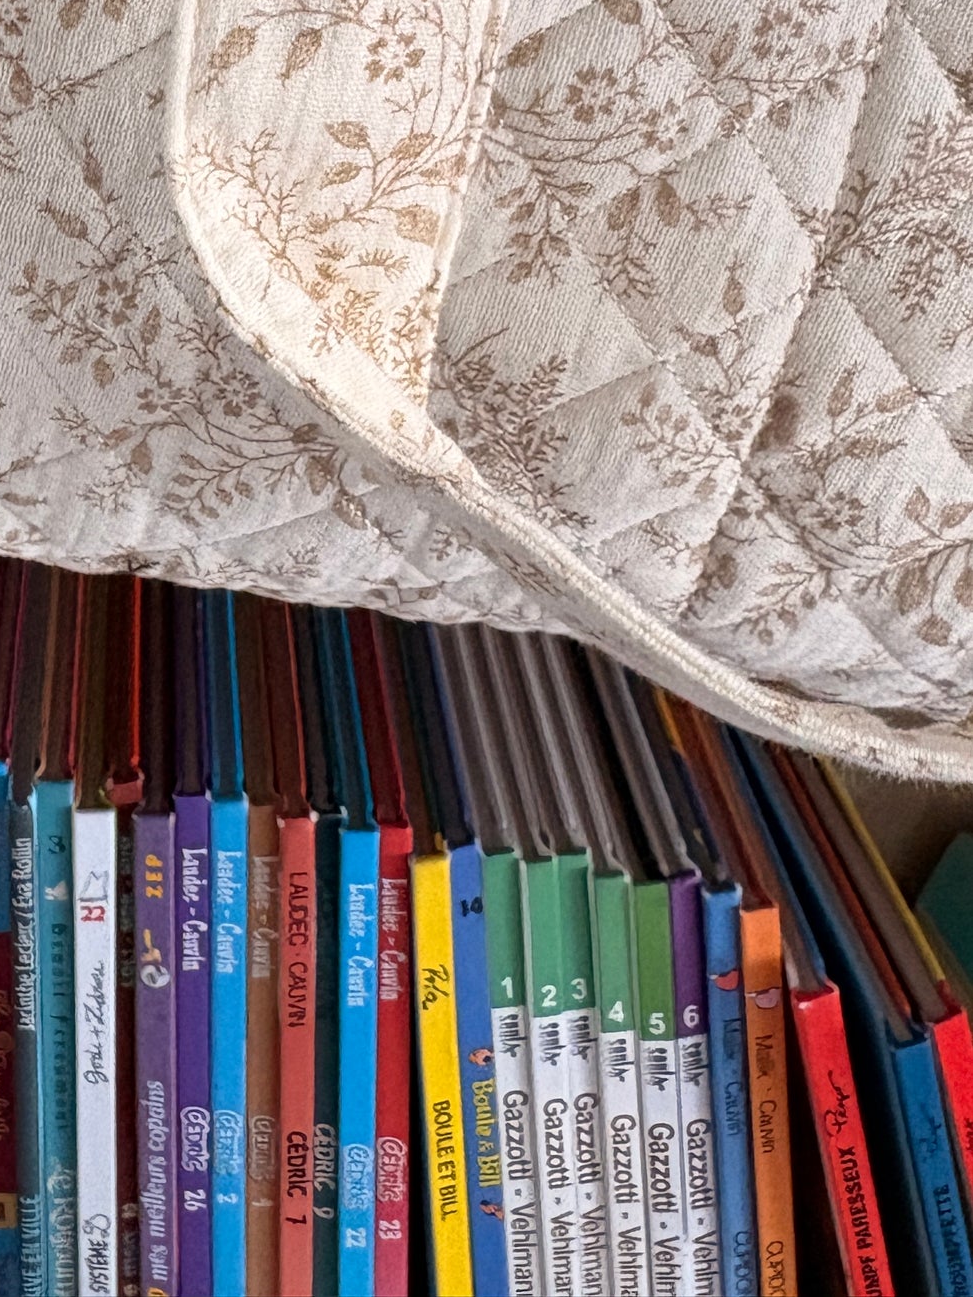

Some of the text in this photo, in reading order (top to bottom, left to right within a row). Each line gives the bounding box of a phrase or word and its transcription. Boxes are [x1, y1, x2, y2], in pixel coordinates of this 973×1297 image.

[11, 837, 33, 880] Rollin
[80, 905, 106, 922] 22
[288, 871, 308, 1028] LAUDEC CAUVIN
[14, 973, 36, 1032] Jacinthe
[501, 977, 514, 999] 1
[541, 985, 557, 1008] 2
[571, 978, 587, 1003] 3
[608, 1001, 625, 1022] 4
[648, 1013, 667, 1035] 5
[682, 1005, 700, 1028] 6
[432, 1100, 456, 1159] BOULE
[472, 1078, 502, 1188] Boule Bill
[503, 1089, 535, 1181] Gazzotti
[543, 1098, 574, 1190] Gazzotti
[574, 1092, 603, 1185] Gazzotti
[139, 1080, 170, 1282] mes meilleurs copains
[437, 1160, 456, 1183] ET
[610, 1114, 641, 1204] Gazzotti
[648, 1122, 680, 1214] Gazzotti
[686, 1118, 716, 1210] Gazzotti
[19, 1194, 41, 1239] VILLE
[184, 1189, 207, 1211] 26
[313, 1207, 335, 1220] 9
[838, 1145, 874, 1251] PARESSEUX
